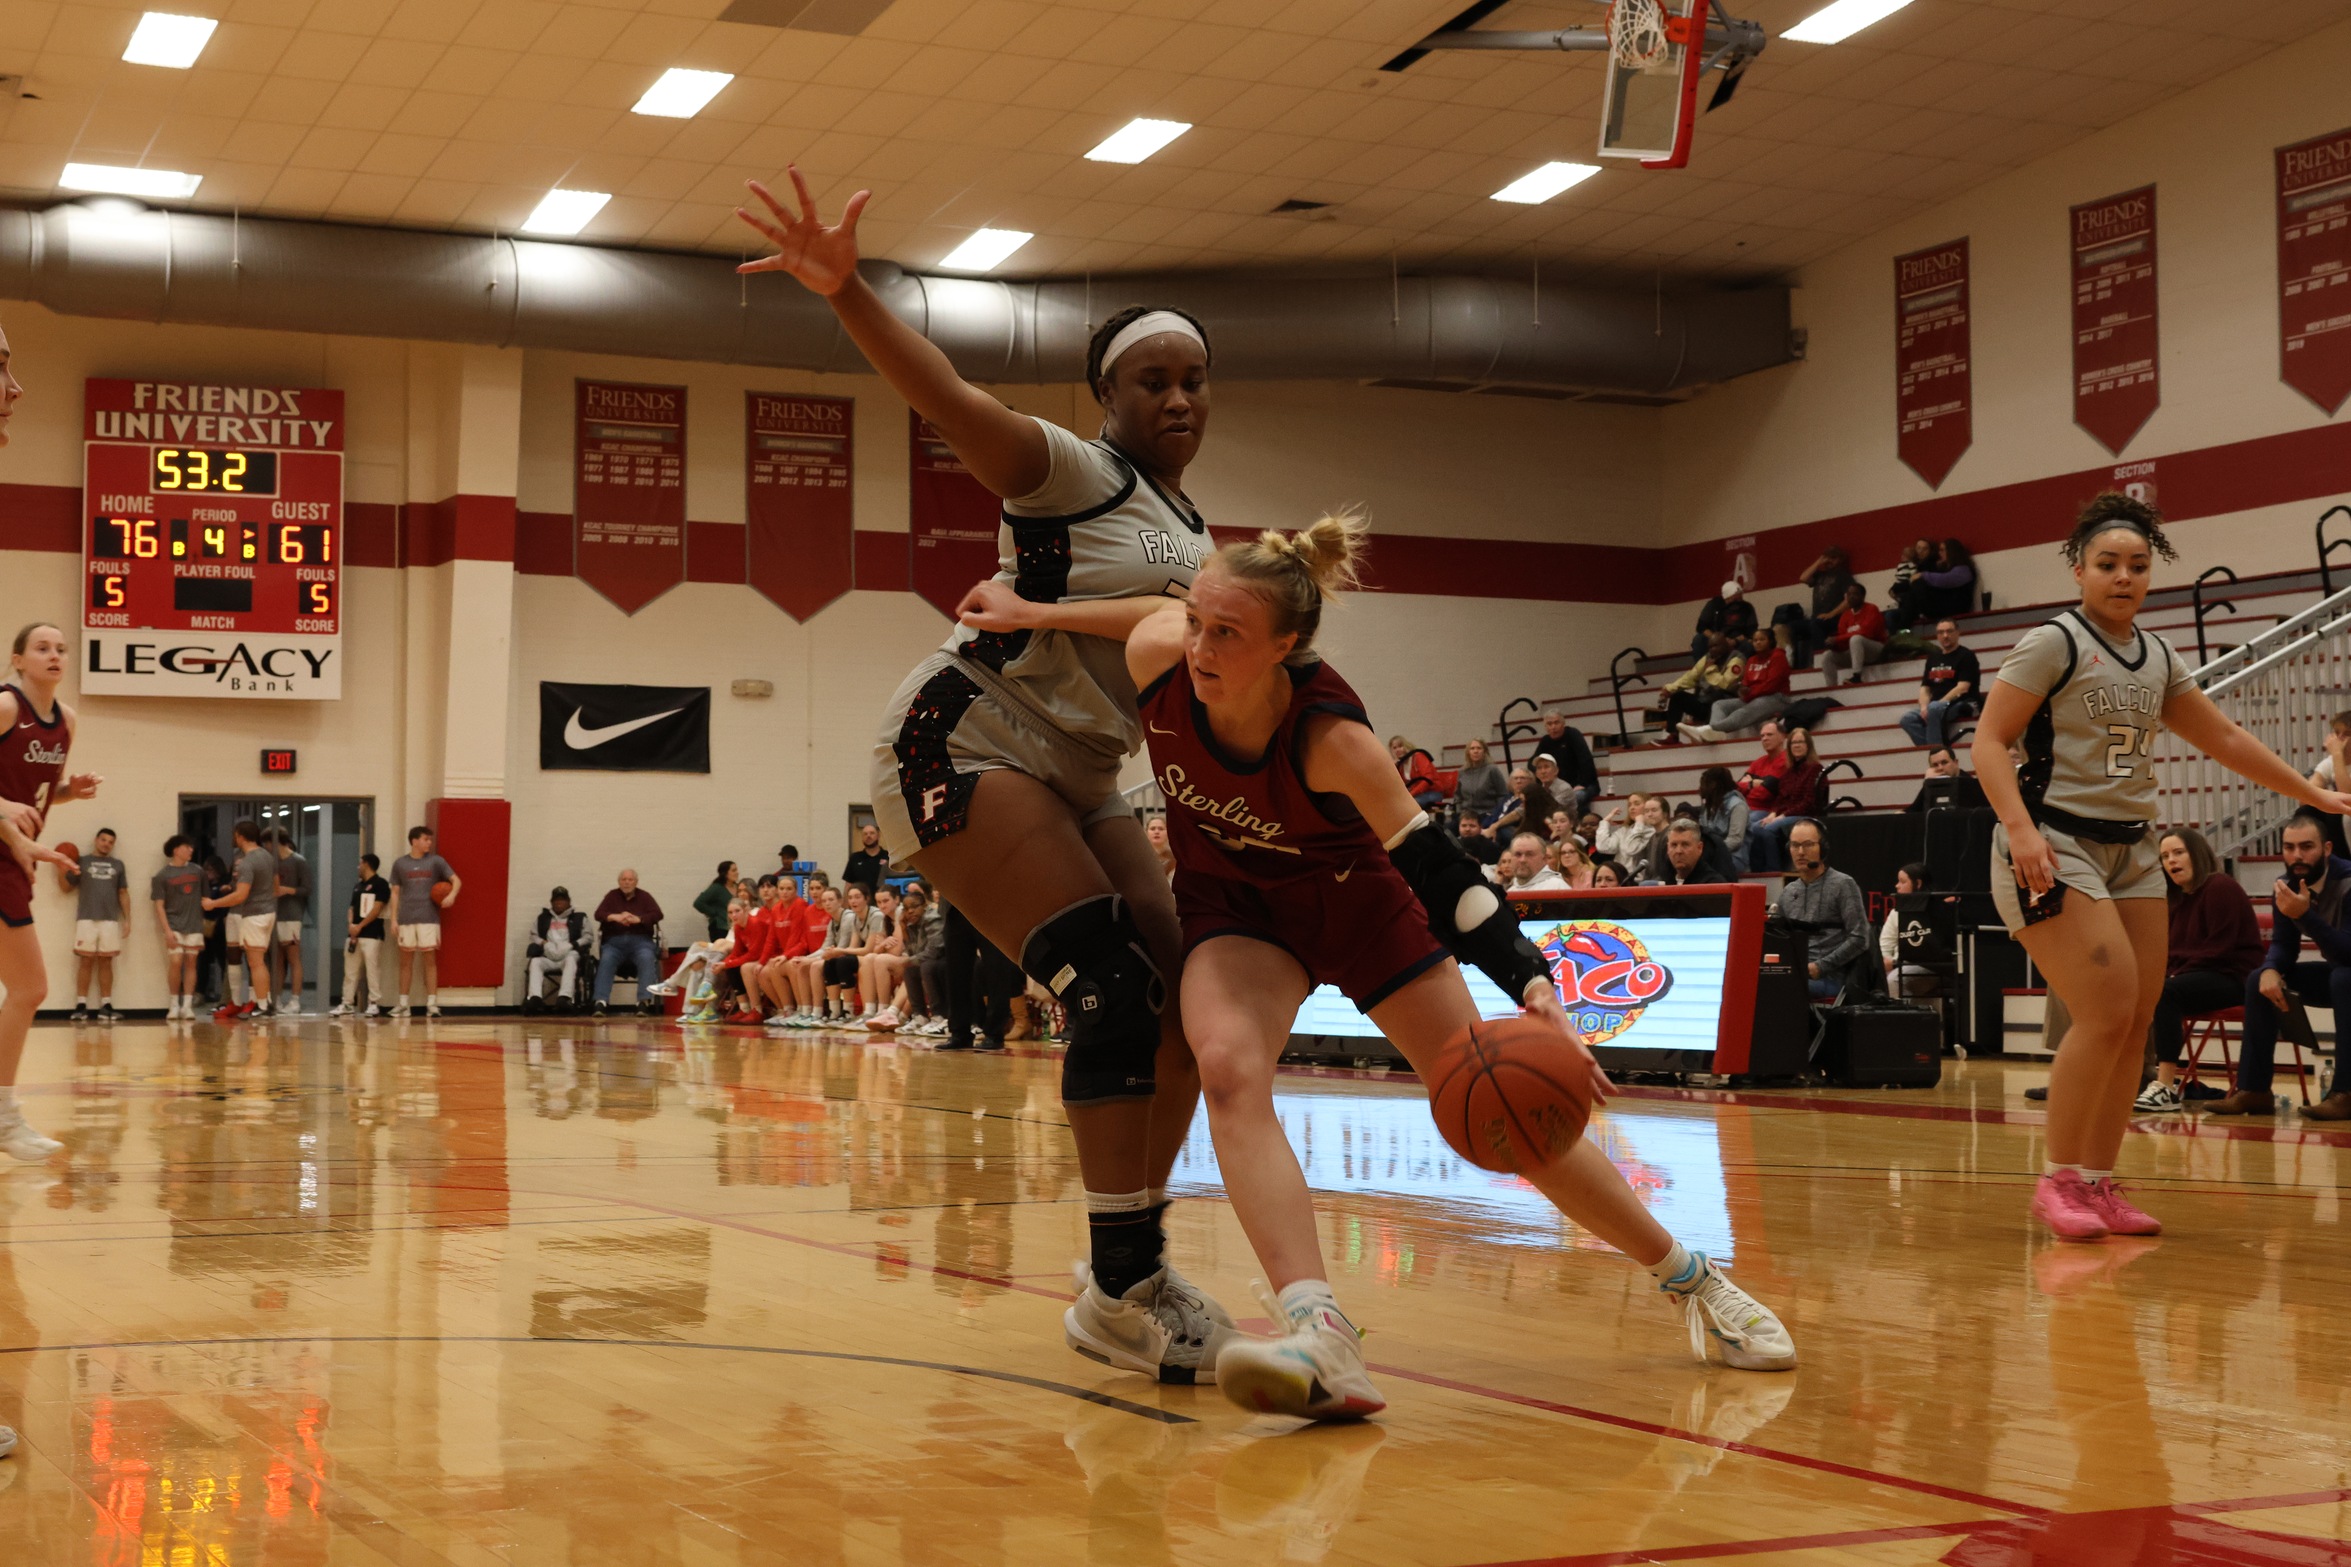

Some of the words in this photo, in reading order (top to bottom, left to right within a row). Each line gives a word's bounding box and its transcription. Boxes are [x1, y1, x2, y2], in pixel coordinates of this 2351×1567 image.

[2078, 197, 2147, 232] FRIENDS
[1902, 248, 1960, 280] FRIENDS
[133, 383, 301, 416] FRIENDS
[587, 385, 675, 410] FRIENDS
[586, 405, 676, 421] UNIVERSITY
[757, 398, 842, 421] FRIENDS
[95, 410, 334, 447] UNIVERSITY
[756, 417, 843, 433] UNIVERSITY
[157, 450, 246, 491] 53.2
[2114, 462, 2155, 480] SECTION
[101, 495, 154, 514] HOME
[192, 508, 237, 522] PERIOD
[271, 501, 330, 521] GUEST
[110, 519, 158, 558] 76
[204, 528, 225, 554] 4
[280, 525, 331, 563] 61
[1725, 536, 1756, 551] SECTION
[90, 561, 130, 575] FOULS
[174, 564, 221, 578] PLAYER
[224, 566, 256, 579] FOUL
[296, 568, 335, 582] FOULS
[1733, 553, 1749, 583] A
[105, 577, 125, 607] 5
[310, 584, 329, 613] 5
[89, 613, 129, 626] SCORE
[191, 616, 234, 629] MATCH
[295, 619, 334, 633] SCORE
[89, 639, 332, 683] LEGACY
[231, 677, 294, 692] Bank
[268, 752, 292, 770] EXIT
[921, 783, 946, 824] F
[1158, 764, 1285, 840] Sterling
[1566, 1013, 1625, 1033] OP
